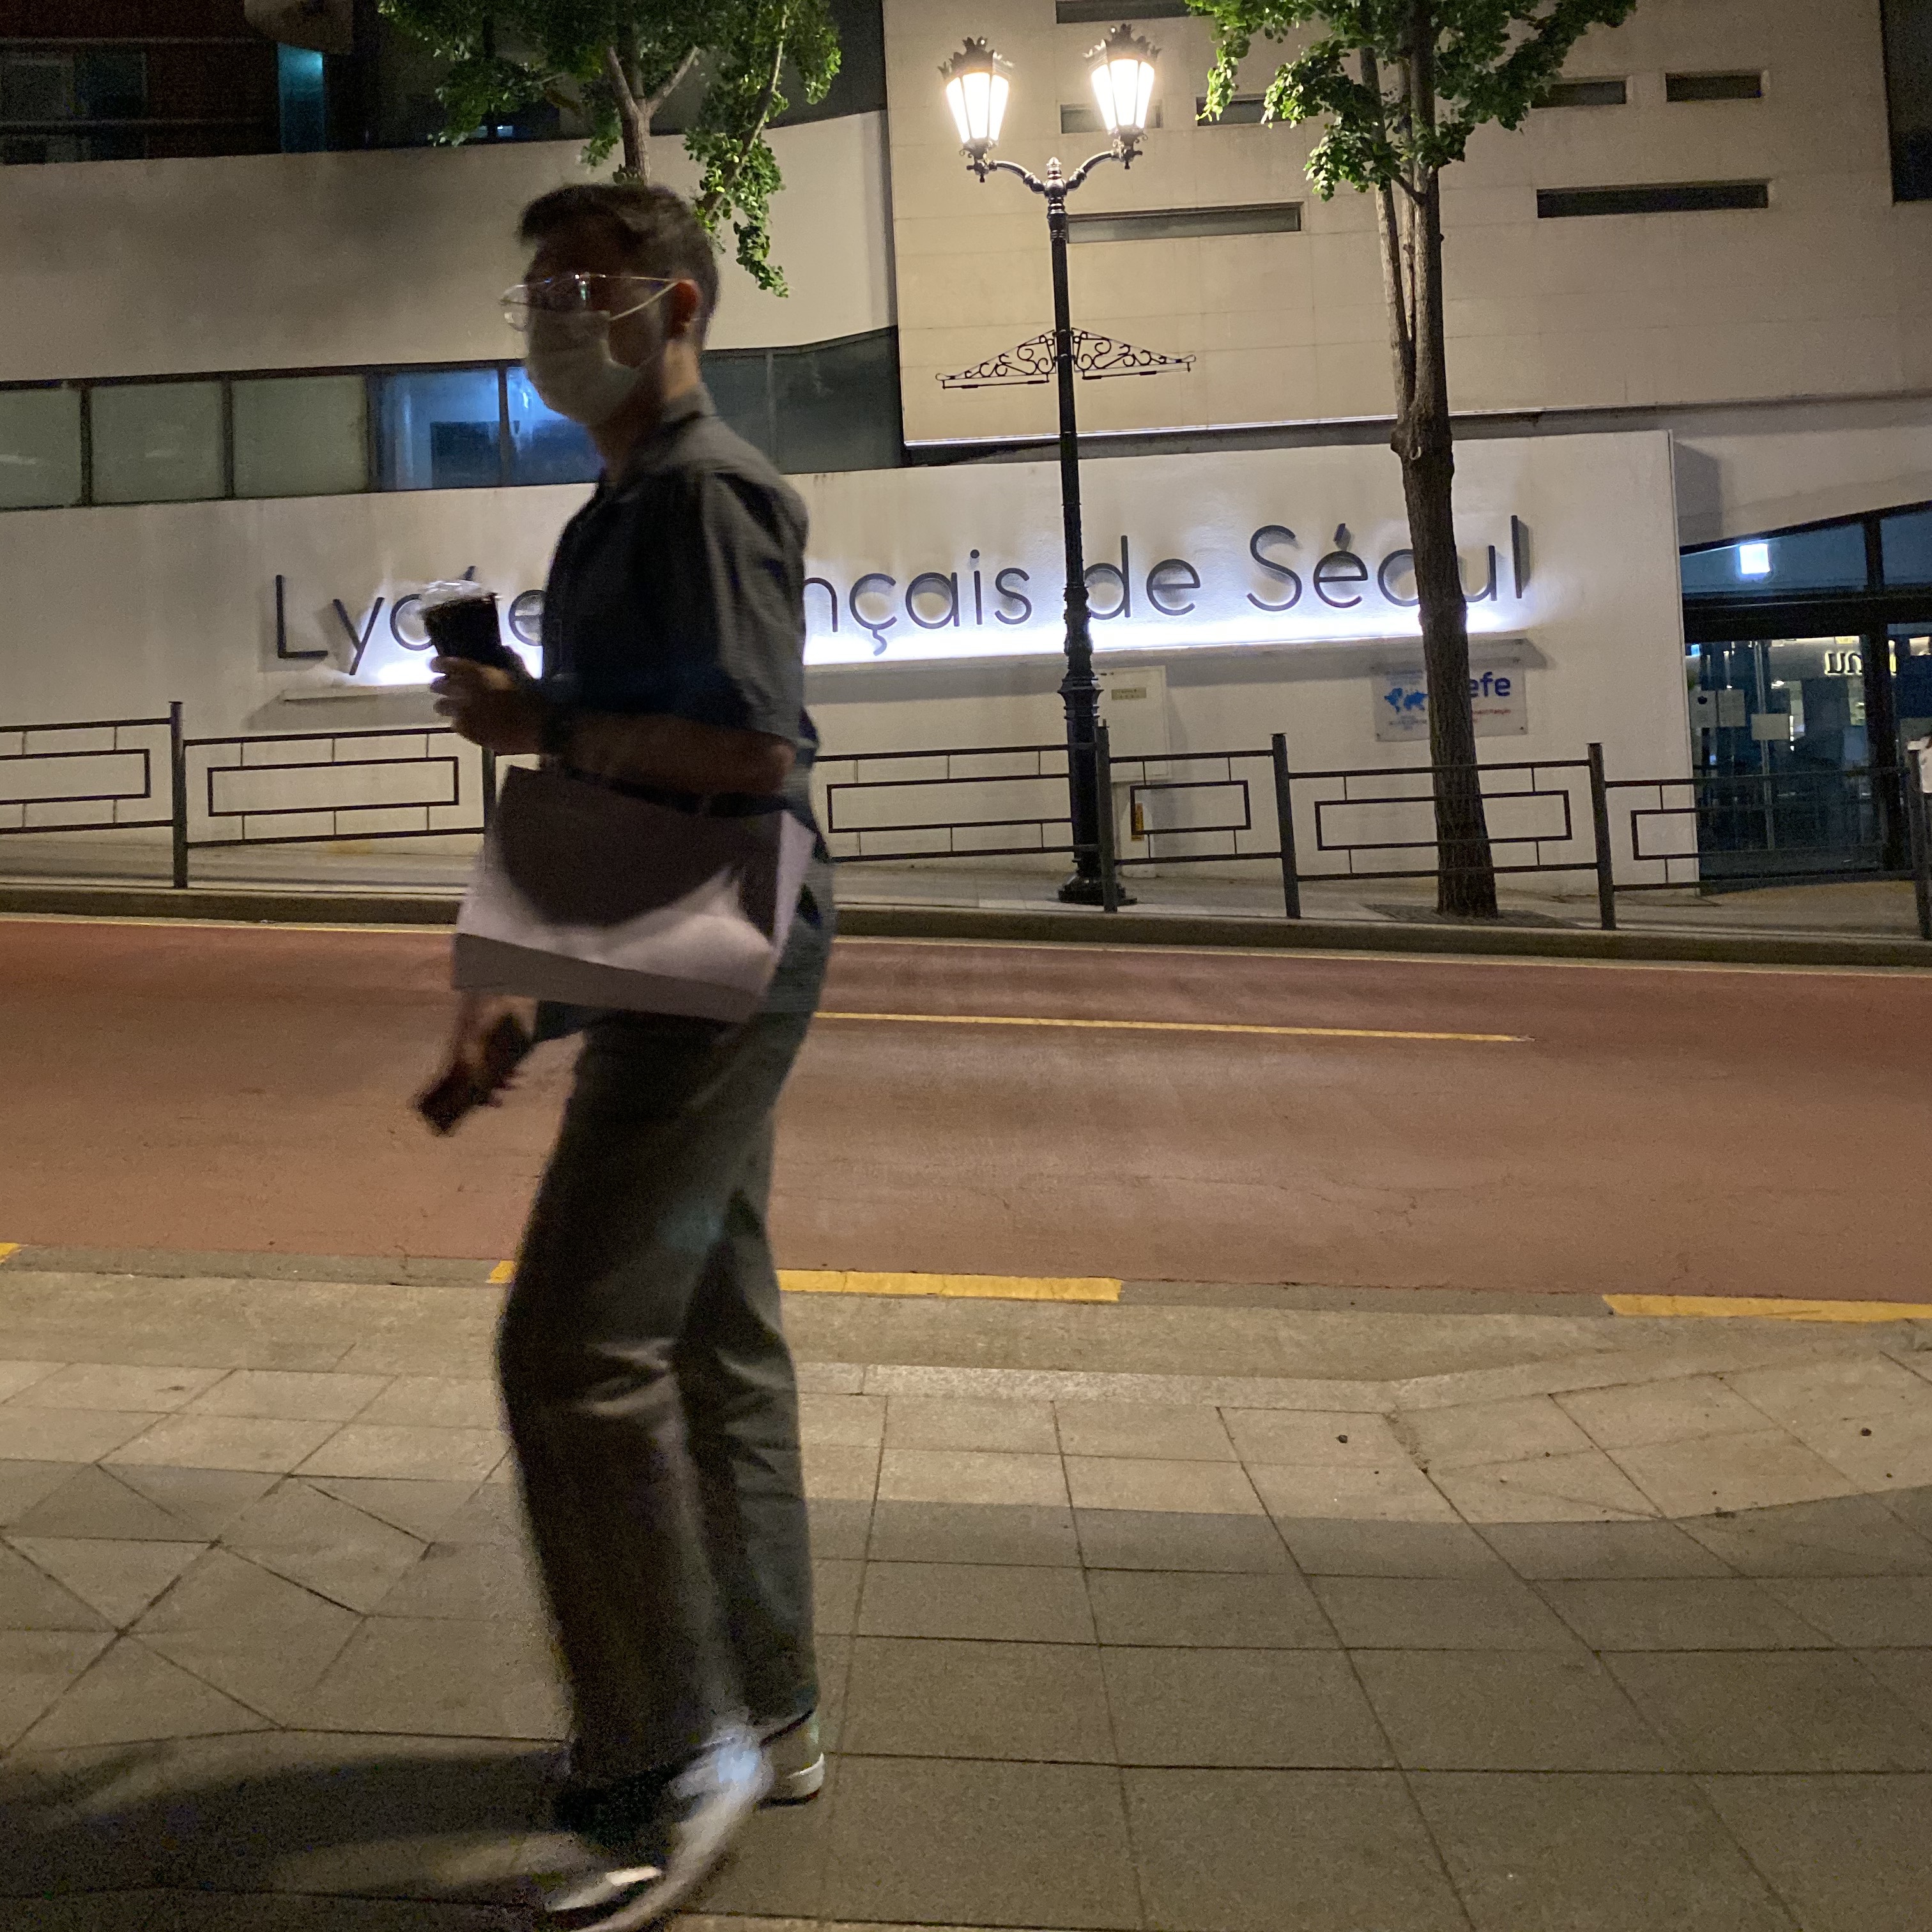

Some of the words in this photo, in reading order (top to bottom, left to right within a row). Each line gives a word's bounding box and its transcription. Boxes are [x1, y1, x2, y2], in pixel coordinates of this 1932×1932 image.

[275, 565, 543, 675] Lyce
[804, 549, 1032, 656] nçais
[1084, 535, 1200, 620] de
[1469, 671, 1510, 698] efe
